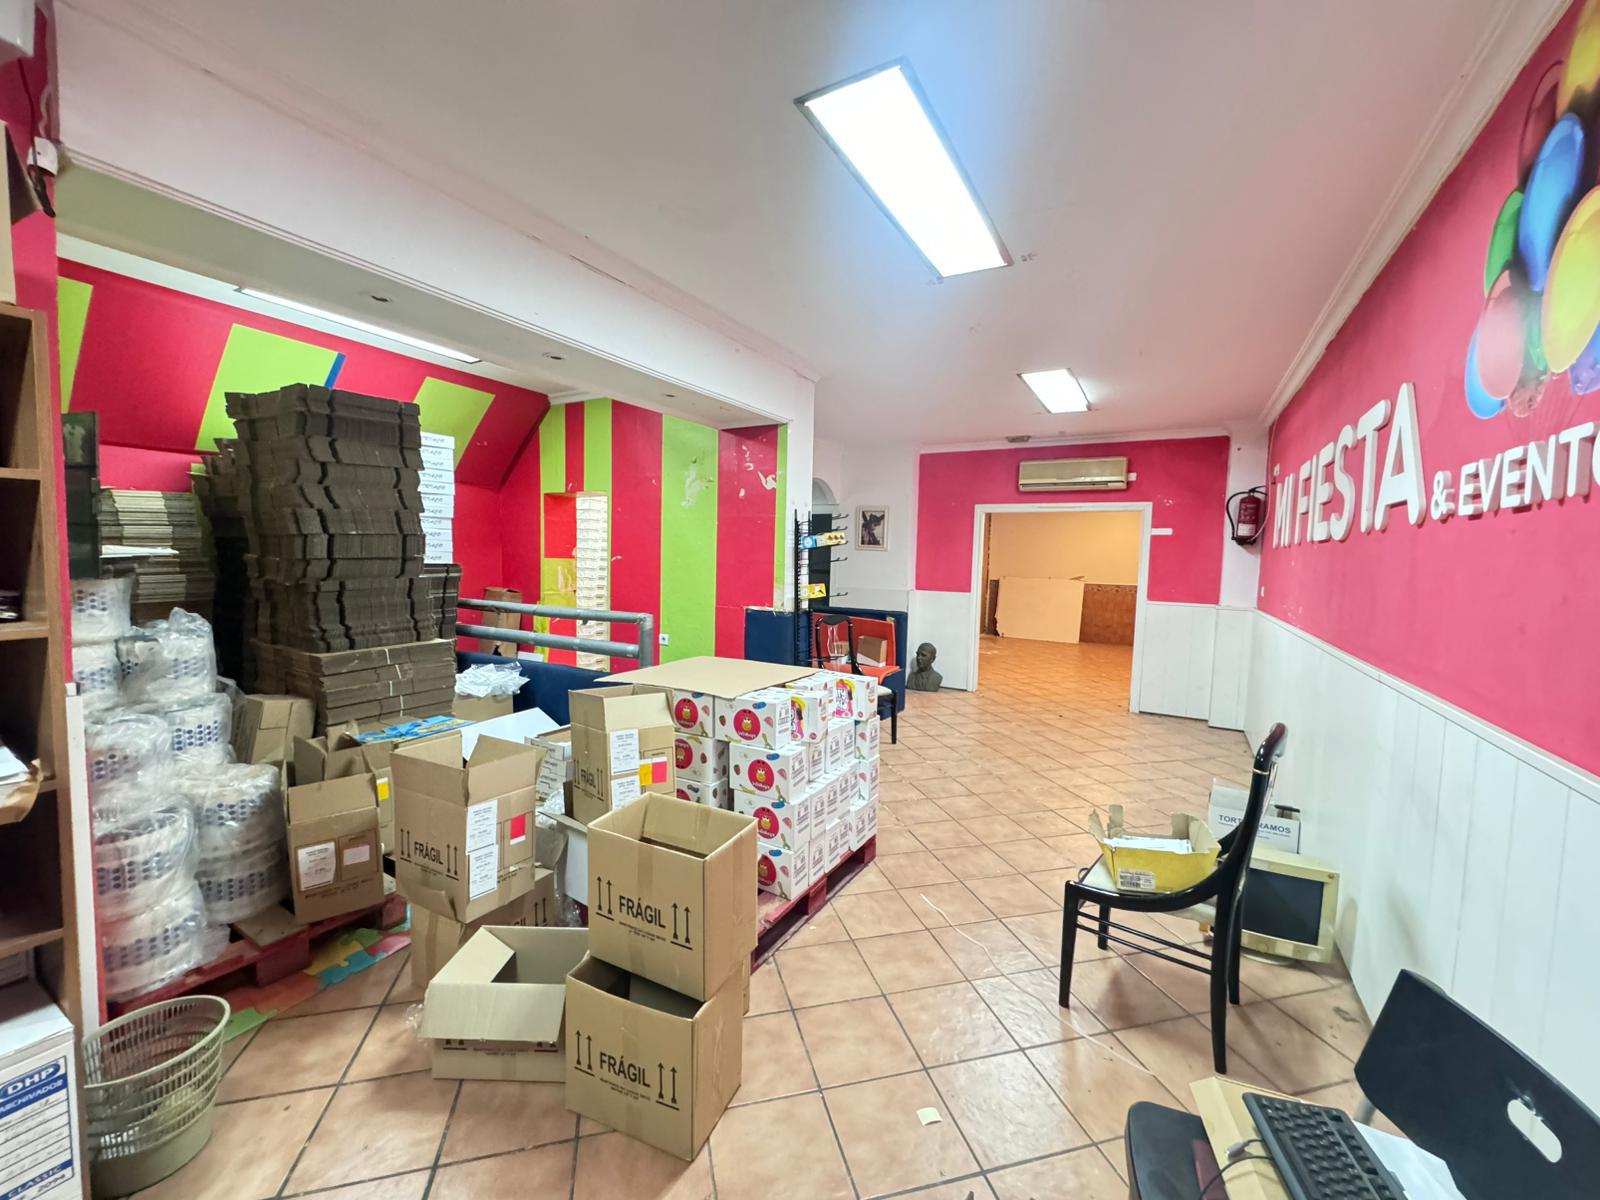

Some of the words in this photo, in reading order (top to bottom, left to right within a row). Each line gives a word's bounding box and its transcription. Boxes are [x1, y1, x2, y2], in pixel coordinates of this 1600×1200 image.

[1272, 473, 1295, 549] MI
[1294, 382, 1427, 545] FIESTA
[1430, 470, 1455, 521] &
[1458, 420, 1600, 517] EVENT
[414, 841, 444, 866] FRÁGIL
[618, 895, 666, 929] FRÁGIL
[7, 1067, 55, 1096] DHP
[599, 1050, 651, 1089] FRÁGIL
[8, 1165, 62, 1198] CLASSIC
